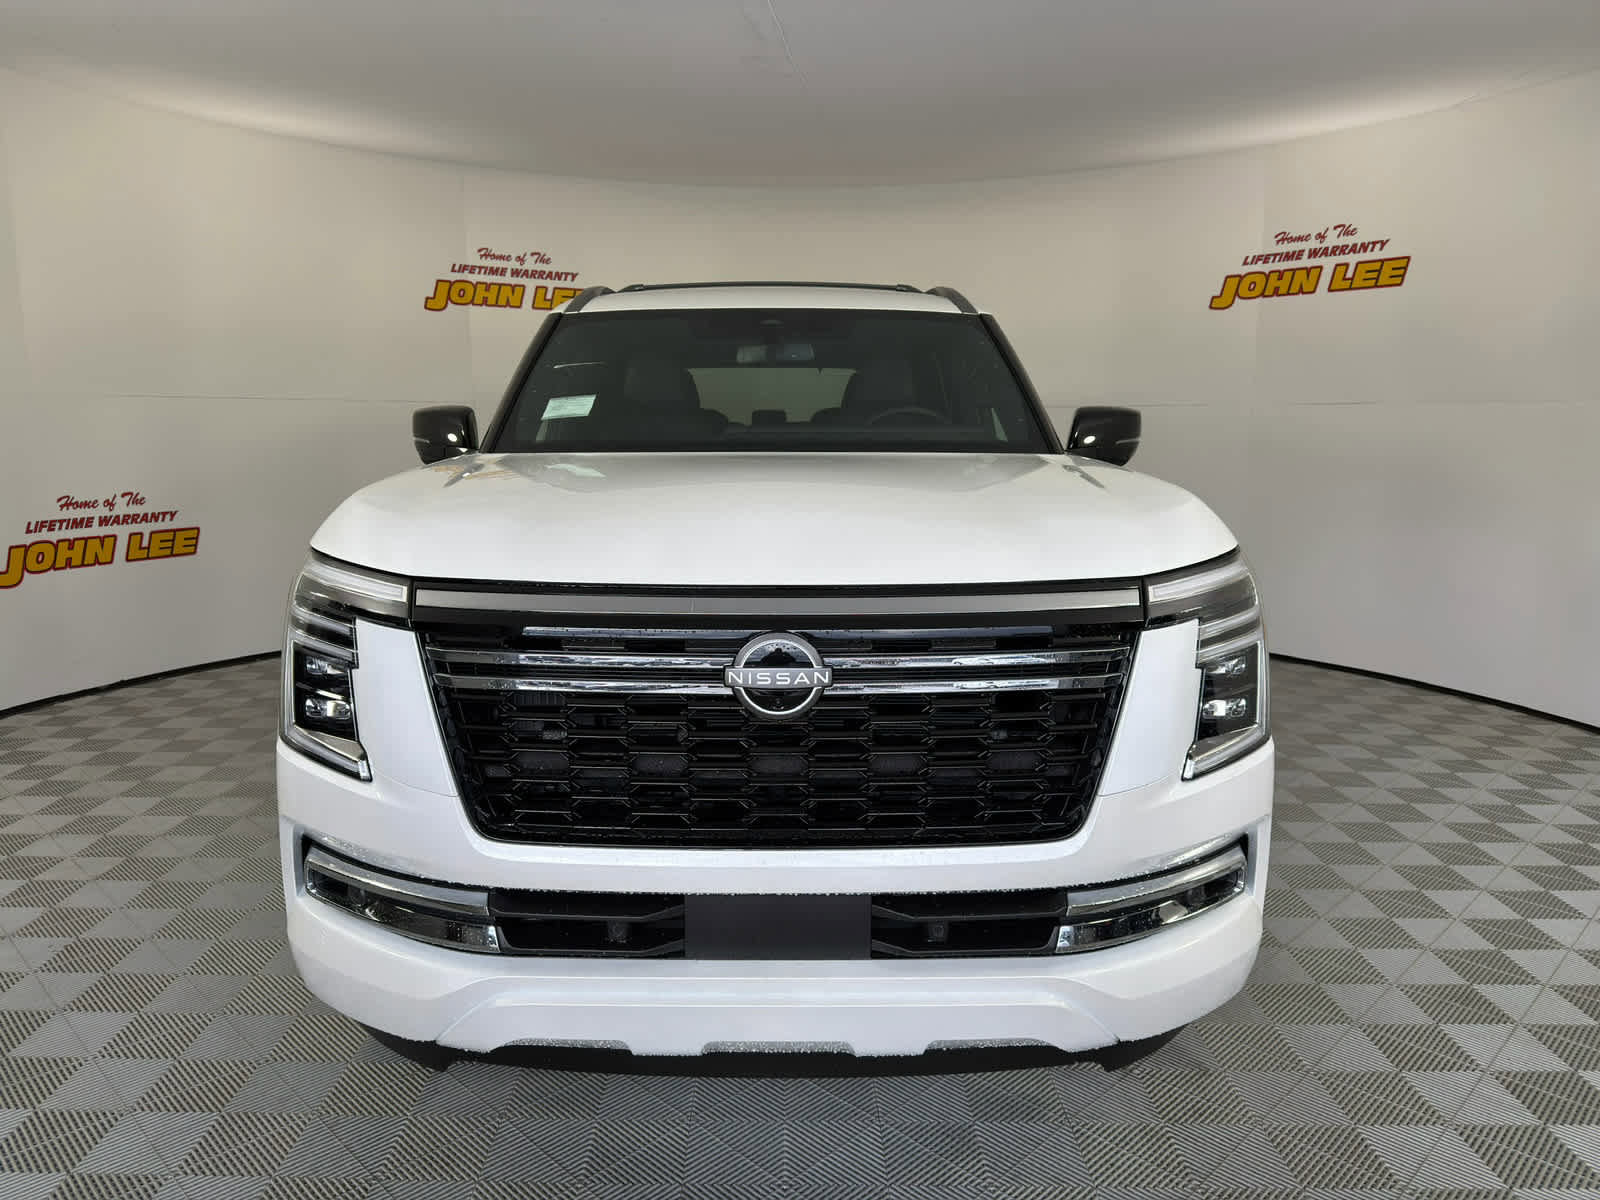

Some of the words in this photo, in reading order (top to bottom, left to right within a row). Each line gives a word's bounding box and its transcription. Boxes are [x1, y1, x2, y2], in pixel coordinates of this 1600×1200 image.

[1274, 231, 1312, 246] Home
[1314, 227, 1329, 242] of
[1333, 223, 1358, 238] The
[477, 247, 512, 261] Home
[515, 252, 527, 265] of
[530, 252, 552, 265] The
[1242, 249, 1305, 266] LIFETIME
[1307, 238, 1390, 259] WARRANTY
[450, 263, 508, 277] LIFETIME
[511, 268, 579, 282] WARRANTY
[1209, 265, 1323, 310] JOHN
[1328, 256, 1411, 292] LEE
[424, 279, 526, 312] JOHN
[532, 286, 584, 310] LE
[57, 495, 100, 511] Home
[103, 494, 117, 512] of
[121, 491, 146, 508] The
[25, 516, 95, 535] LIFETIME
[98, 510, 178, 528] WARRANTY
[0, 534, 118, 589] JOHN
[125, 526, 200, 562] LEE
[728, 671, 829, 685] NISSAN
